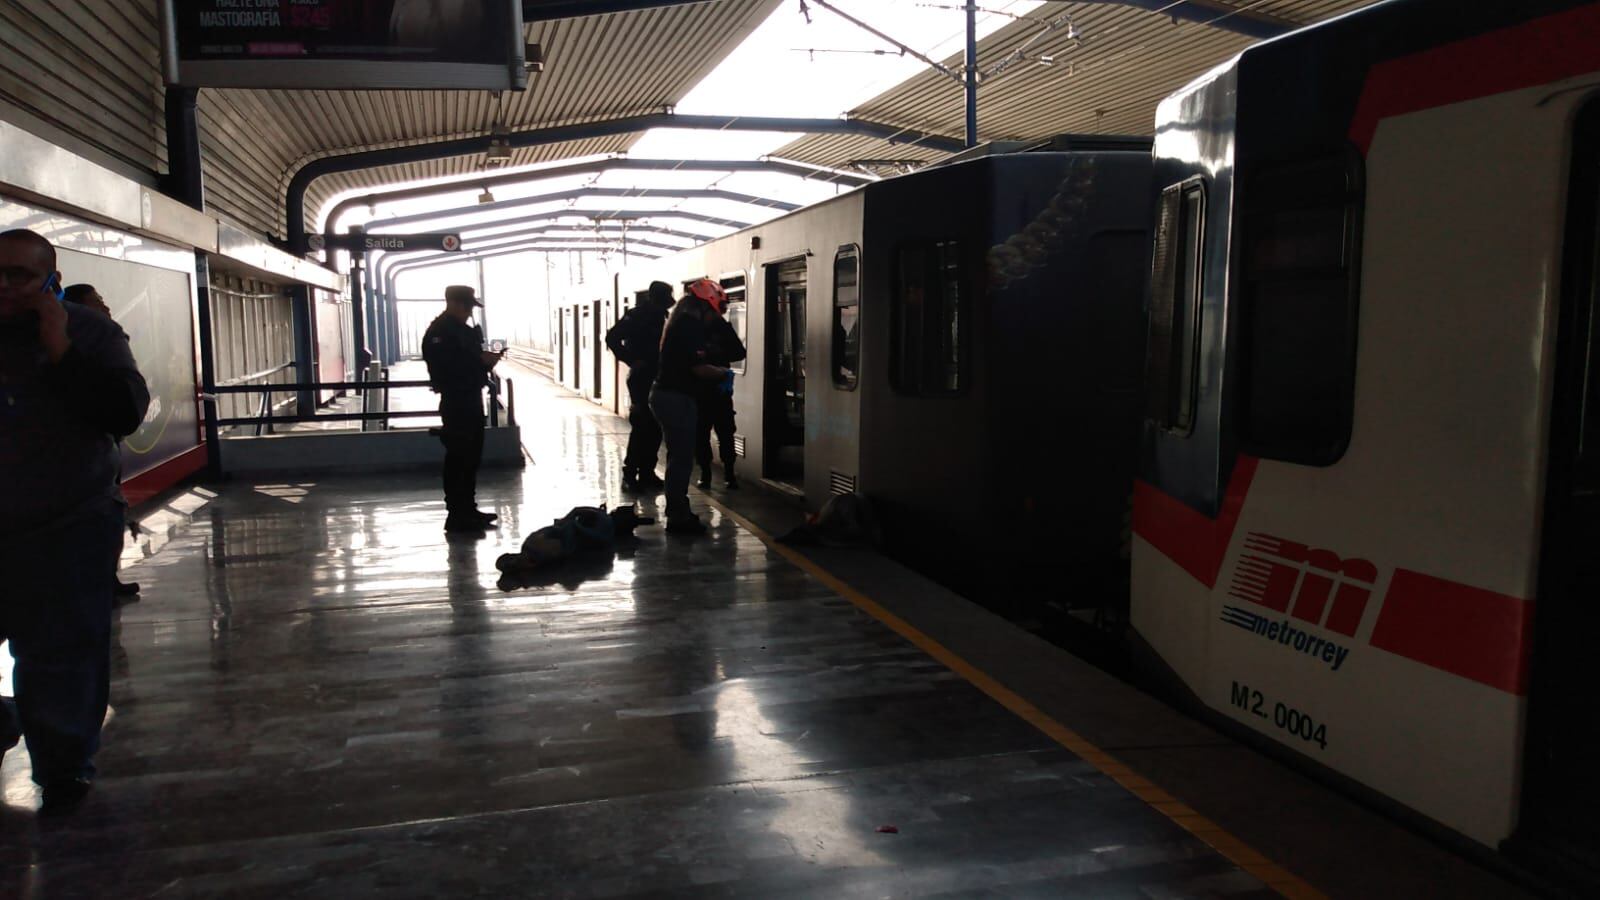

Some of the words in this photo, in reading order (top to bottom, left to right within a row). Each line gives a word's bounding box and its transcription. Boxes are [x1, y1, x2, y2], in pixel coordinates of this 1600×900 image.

[199, 9, 281, 27] MASTOGRAFÍA
[365, 238, 405, 249] Salida
[1250, 613, 1349, 671] metrorrey
